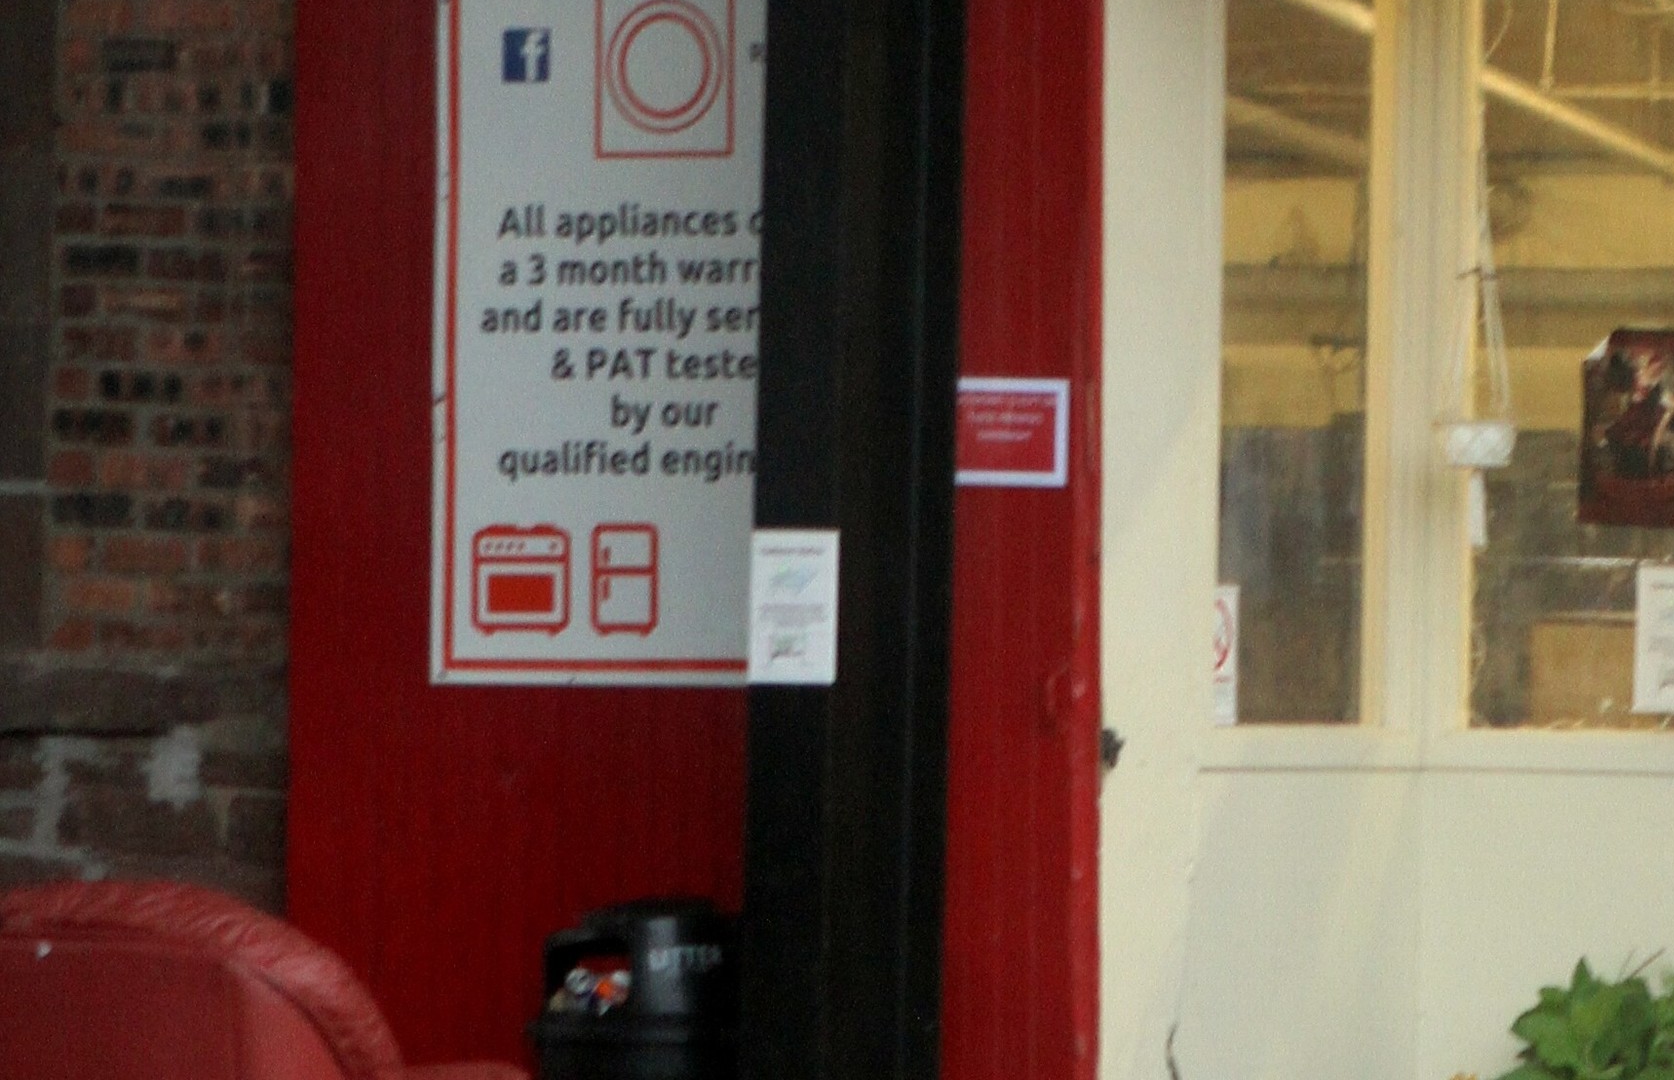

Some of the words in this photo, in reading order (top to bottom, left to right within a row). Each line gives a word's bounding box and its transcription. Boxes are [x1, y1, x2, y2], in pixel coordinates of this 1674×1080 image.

[498, 204, 547, 240] All
[555, 203, 738, 246] appliances
[498, 261, 518, 287] a
[528, 253, 548, 287] 3
[556, 248, 668, 287] month
[480, 299, 542, 334] and
[552, 306, 608, 334] are
[616, 297, 699, 340] fully
[550, 350, 577, 381] &
[585, 348, 659, 381] PAT
[609, 394, 652, 435] by
[660, 400, 719, 429] our
[498, 441, 651, 483] qualified
